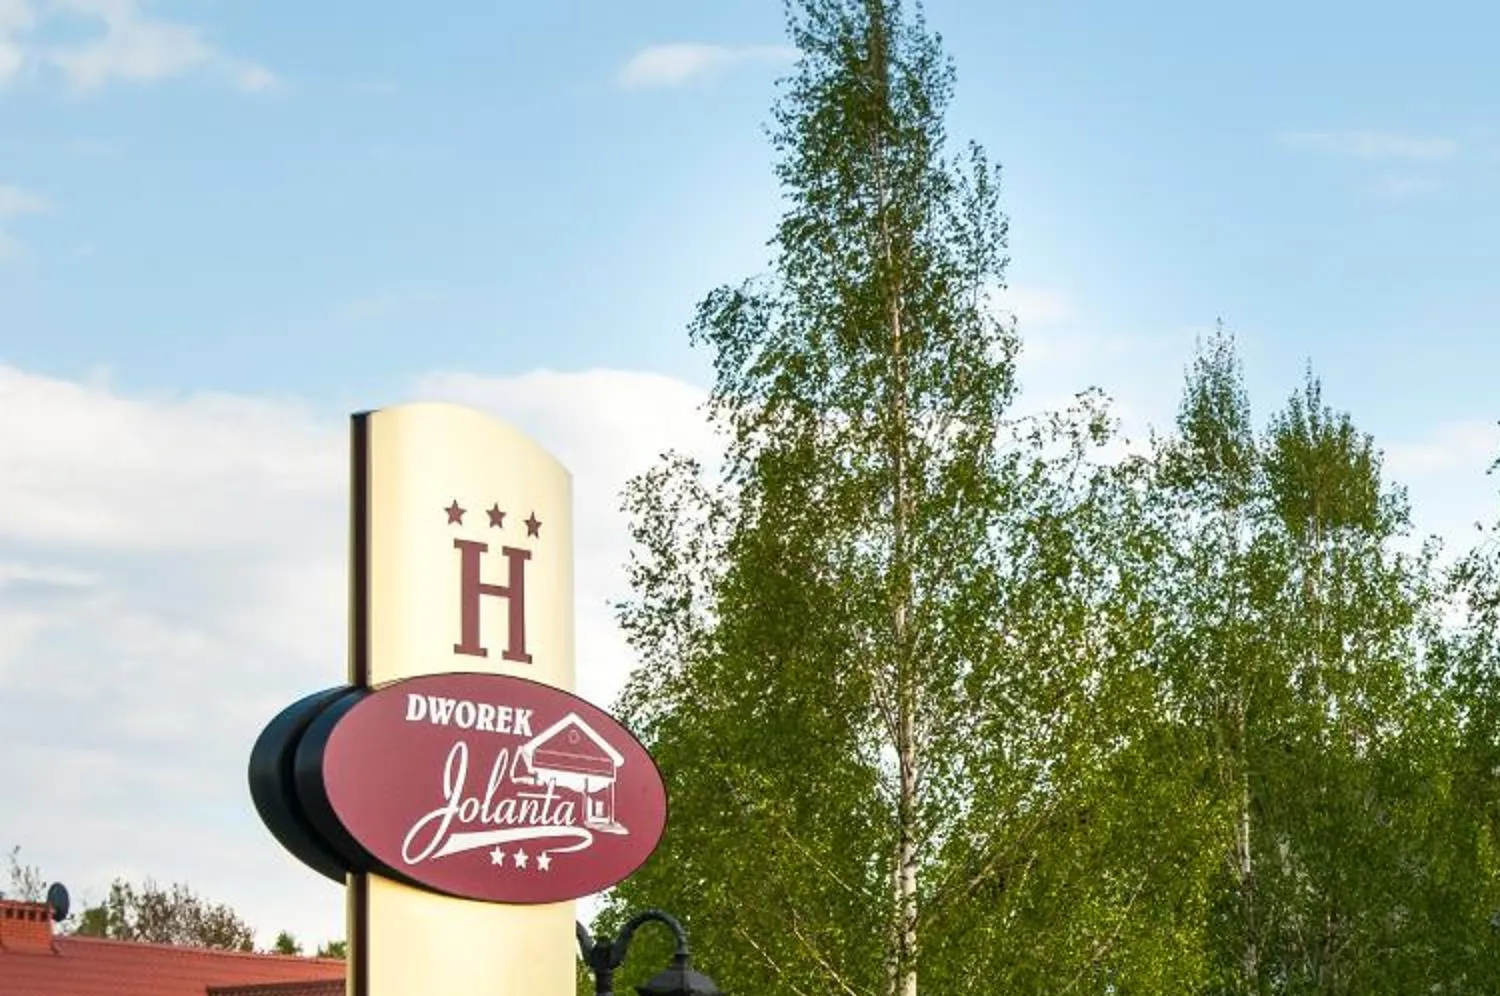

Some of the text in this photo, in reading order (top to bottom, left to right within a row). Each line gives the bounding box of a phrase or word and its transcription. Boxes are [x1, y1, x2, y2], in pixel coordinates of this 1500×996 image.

[453, 538, 533, 664] H
[405, 693, 534, 738] DWOREK
[402, 740, 576, 865] Jolanta
